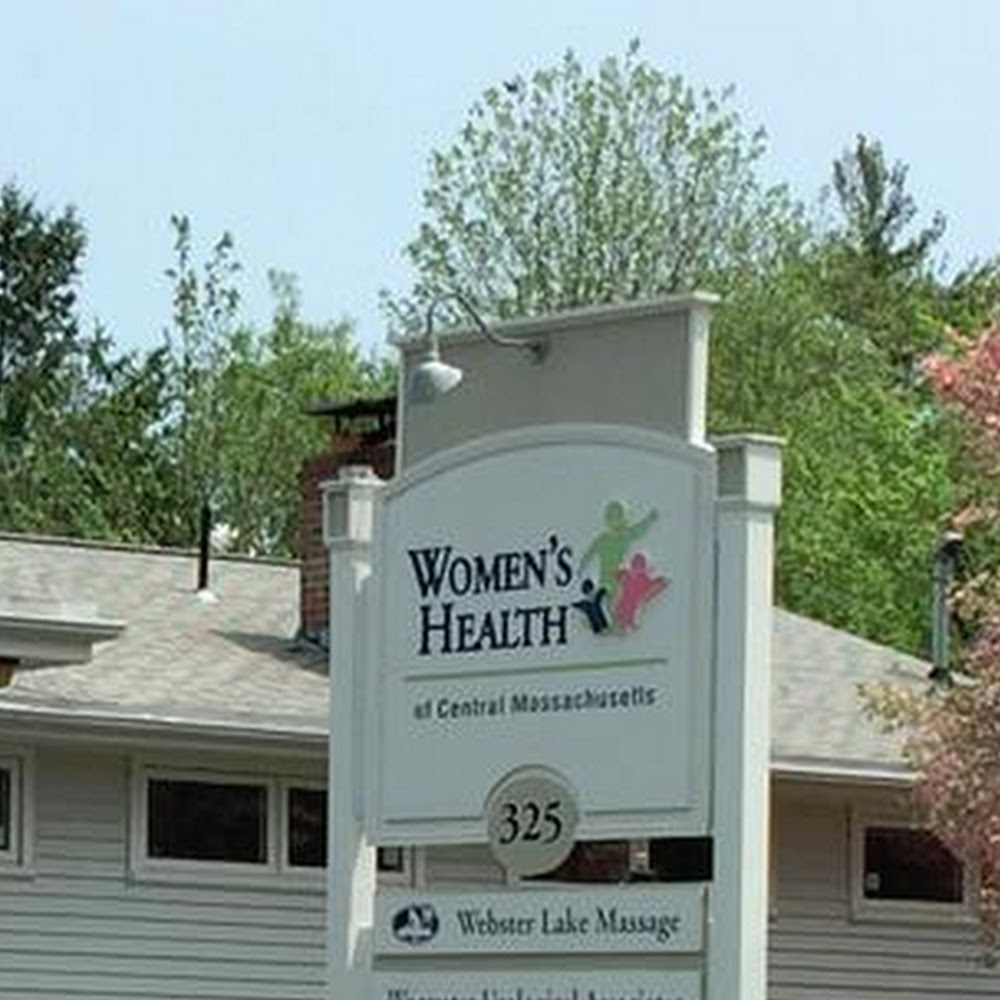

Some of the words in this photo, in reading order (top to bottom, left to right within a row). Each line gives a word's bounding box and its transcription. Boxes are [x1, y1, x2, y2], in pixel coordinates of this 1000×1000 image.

[408, 536, 573, 598] WOMEN'S
[418, 603, 568, 655] HEALTH
[414, 701, 431, 719] of
[437, 696, 506, 719] Central
[499, 801, 563, 845] 325
[457, 909, 534, 936] Webster
[541, 908, 588, 935] Lake
[595, 906, 681, 943] Massage
